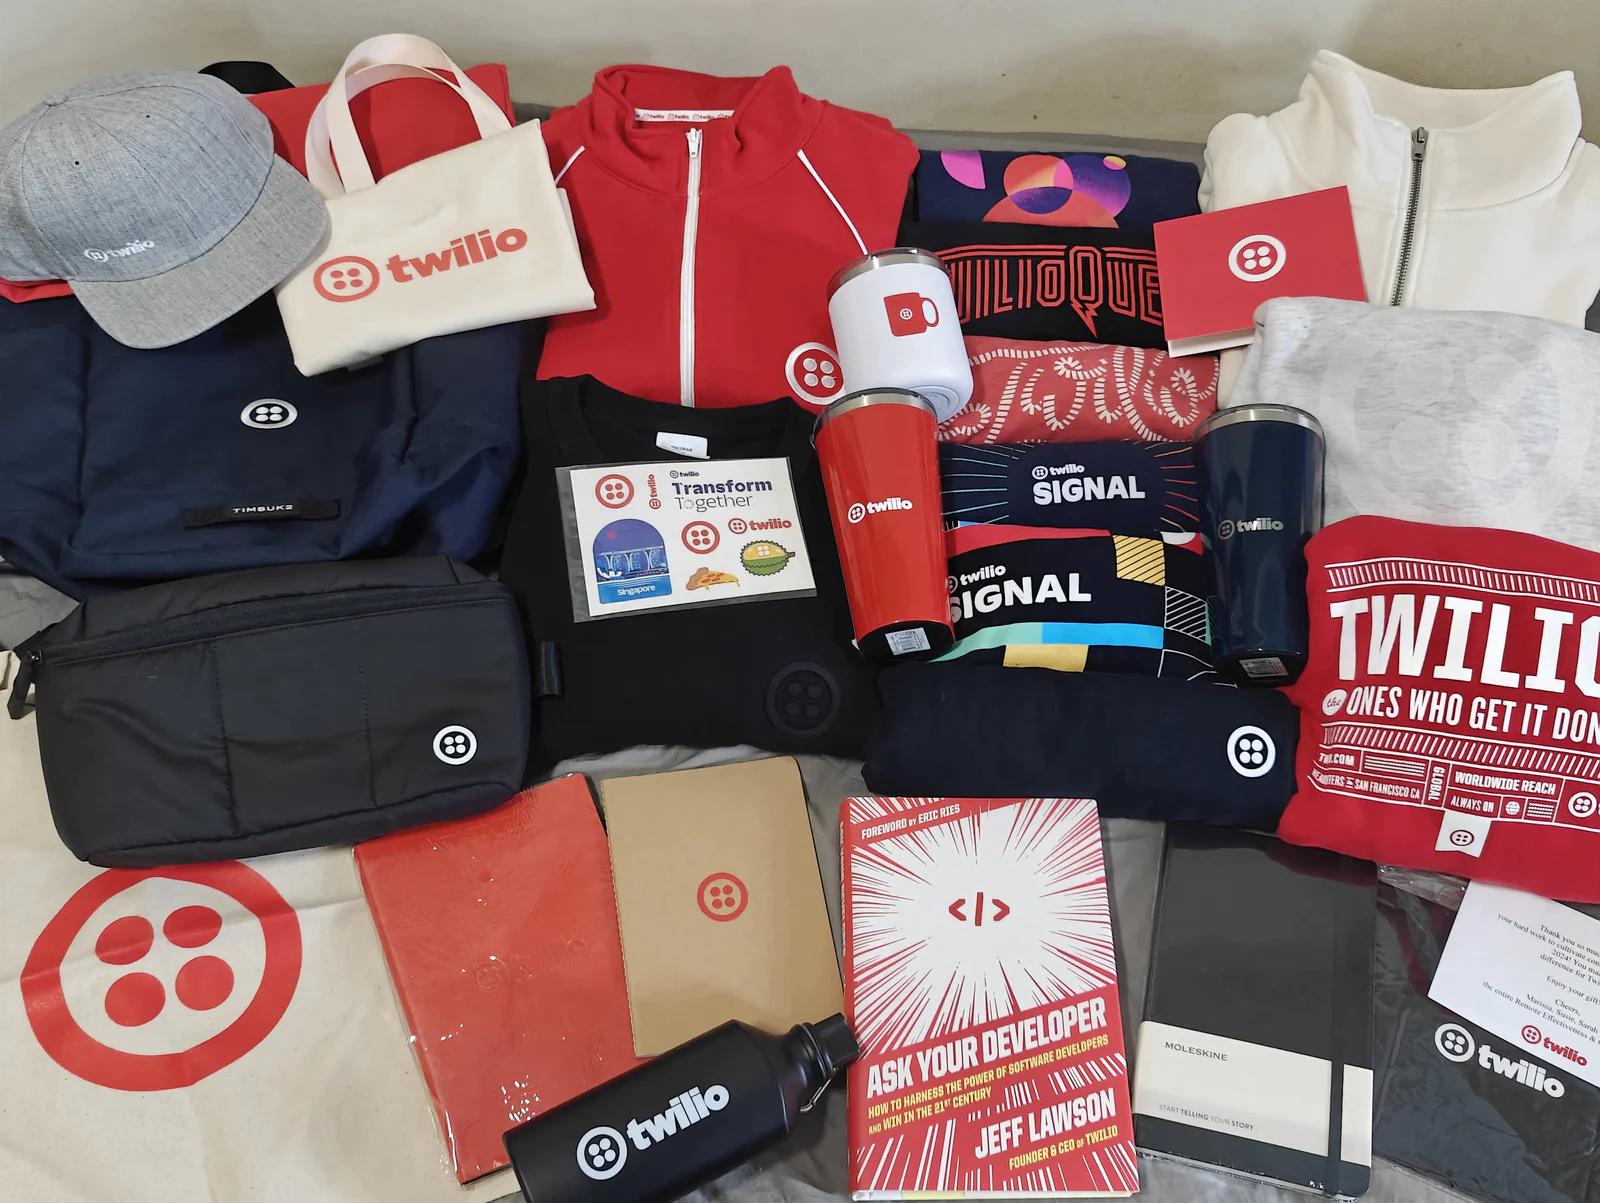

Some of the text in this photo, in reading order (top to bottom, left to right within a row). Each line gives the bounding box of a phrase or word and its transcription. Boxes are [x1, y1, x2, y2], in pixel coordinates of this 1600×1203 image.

[386, 228, 528, 284] twilio
[679, 470, 700, 478] twilio
[1049, 463, 1086, 476] twilio
[647, 473, 659, 498] twilio
[671, 478, 773, 496] Transform
[1032, 475, 1146, 506] SIGNAL
[233, 504, 294, 514] TIMBUK2
[673, 494, 754, 513] Together
[866, 497, 913, 515] twilio
[749, 517, 793, 532] twilio
[1236, 517, 1284, 533] twilio
[959, 564, 1007, 586] twilio
[617, 583, 656, 597] Singapore
[1346, 685, 1403, 719] ONES
[1409, 688, 1464, 726] WHO
[1469, 697, 1517, 733] GET
[1520, 702, 1549, 737] IT
[1354, 778, 1369, 791] SAN
[1369, 782, 1409, 798] FRANCISCO
[1410, 788, 1421, 800] CA
[1428, 765, 1446, 801] GLOBAL
[1454, 771, 1557, 796] WORLDWIDE REACH
[1450, 795, 1495, 813] ALWAYS ON
[861, 803, 961, 840] FOREWORD BY ERIC RIES
[1497, 913, 1513, 925] your
[1513, 920, 1529, 933] hard
[1529, 930, 1547, 941] work
[1556, 942, 1586, 960] cultivate
[1540, 924, 1561, 939] Thank
[1562, 936, 1576, 946] you
[1540, 954, 1574, 974] difference
[1575, 969, 1586, 979] for
[1551, 949, 1572, 962] 2024!
[1574, 958, 1587, 970] You
[1546, 975, 1568, 990] Enjoy
[1568, 986, 1585, 998] your
[1482, 981, 1597, 1043] the entire Remote Effectiveness &
[1526, 993, 1598, 1034] Marissa, Susie, Sarah
[1555, 998, 1581, 1016] Cheers,
[866, 996, 1108, 1100] ASK YOUR DEVELOPER
[1165, 1041, 1229, 1062] MOLESKINE
[1543, 1036, 1588, 1067] twilio
[868, 1034, 1109, 1119] HOW TO HARNESS THE POWER OF SOFTWARE DEVELOPERS
[1478, 1044, 1566, 1099] twilio
[625, 1083, 731, 1151] twilio
[868, 1123, 882, 1135] AND
[882, 1113, 902, 1130] WIN
[903, 1109, 915, 1124] IN
[916, 1104, 933, 1119] THE
[952, 1086, 992, 1109] CENTURY
[1158, 1103, 1255, 1132] START TELLING YOUR STORY
[974, 1087, 1117, 1160] JEFF LAWSON
[1008, 1146, 1049, 1170] FOUNDER
[1050, 1144, 1058, 1157] &
[1058, 1138, 1075, 1154] CEO
[1085, 1124, 1119, 1146] TWILIO
